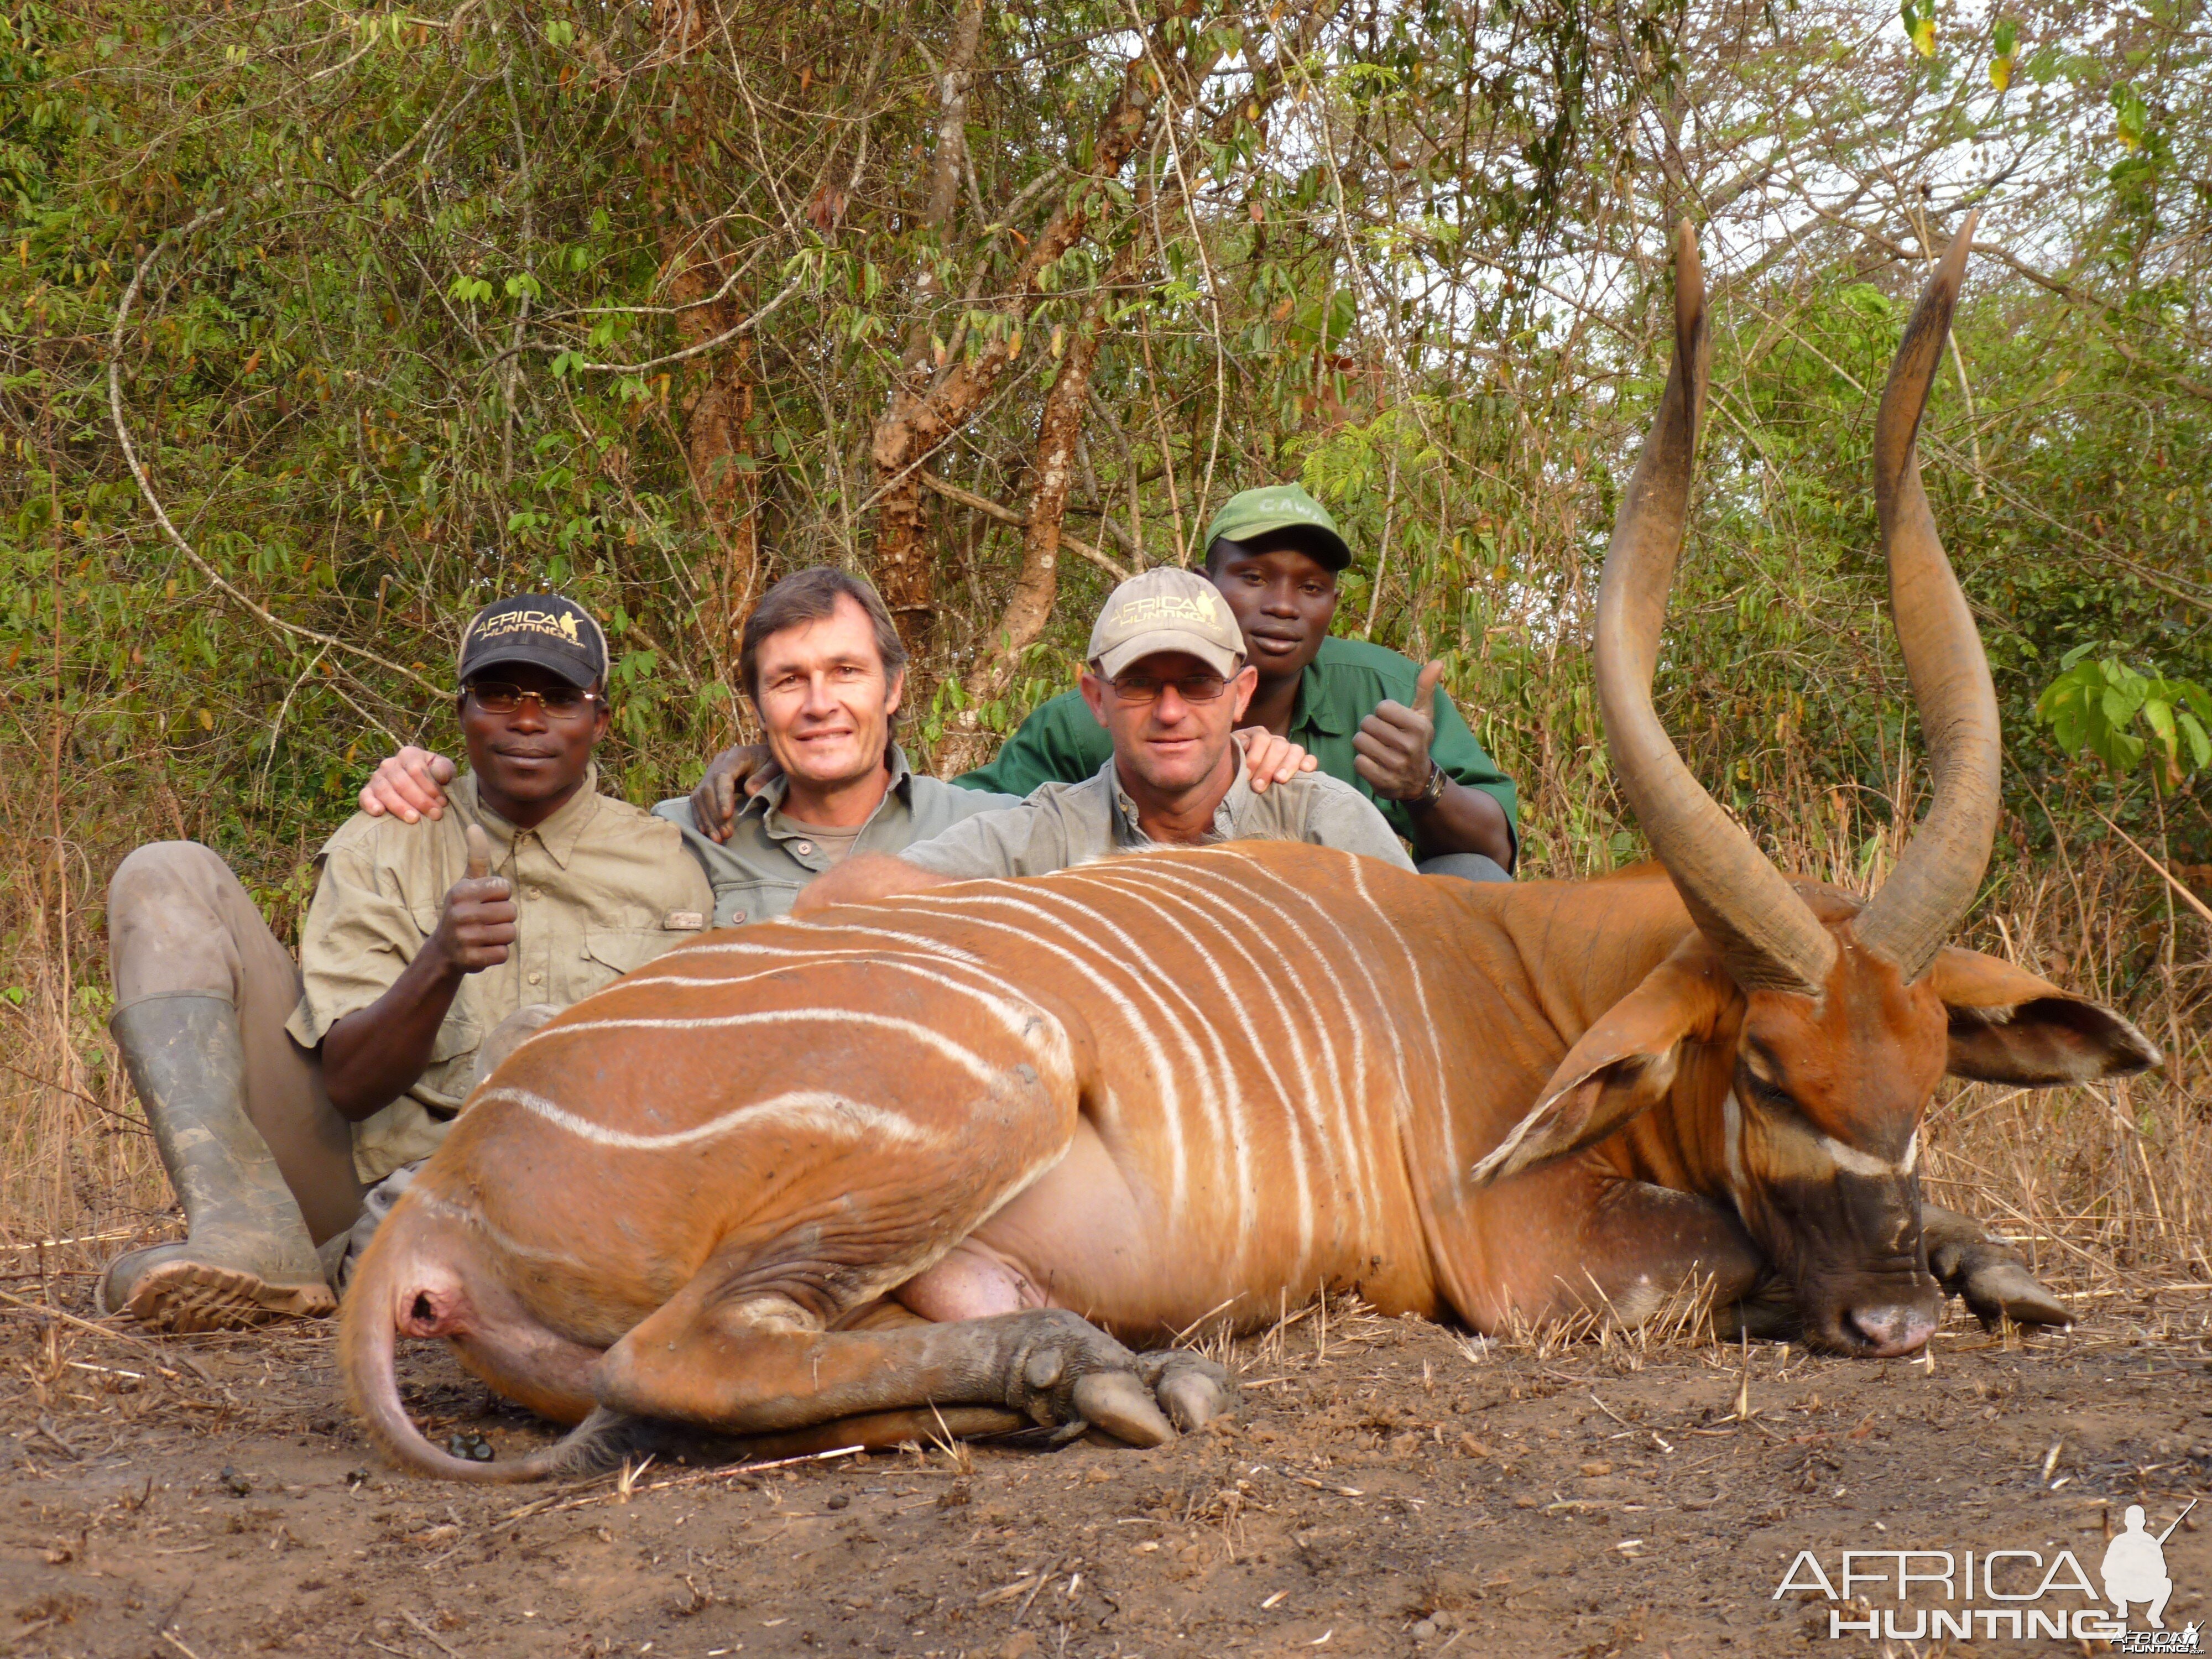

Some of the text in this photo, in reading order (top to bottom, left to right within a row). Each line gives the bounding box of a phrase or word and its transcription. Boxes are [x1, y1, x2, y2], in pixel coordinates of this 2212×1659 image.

[1108, 596, 1198, 627] AFRICA
[1120, 609, 1206, 627] HUNTING
[473, 611, 560, 635] AFRICA
[479, 623, 566, 641] HUNTING
